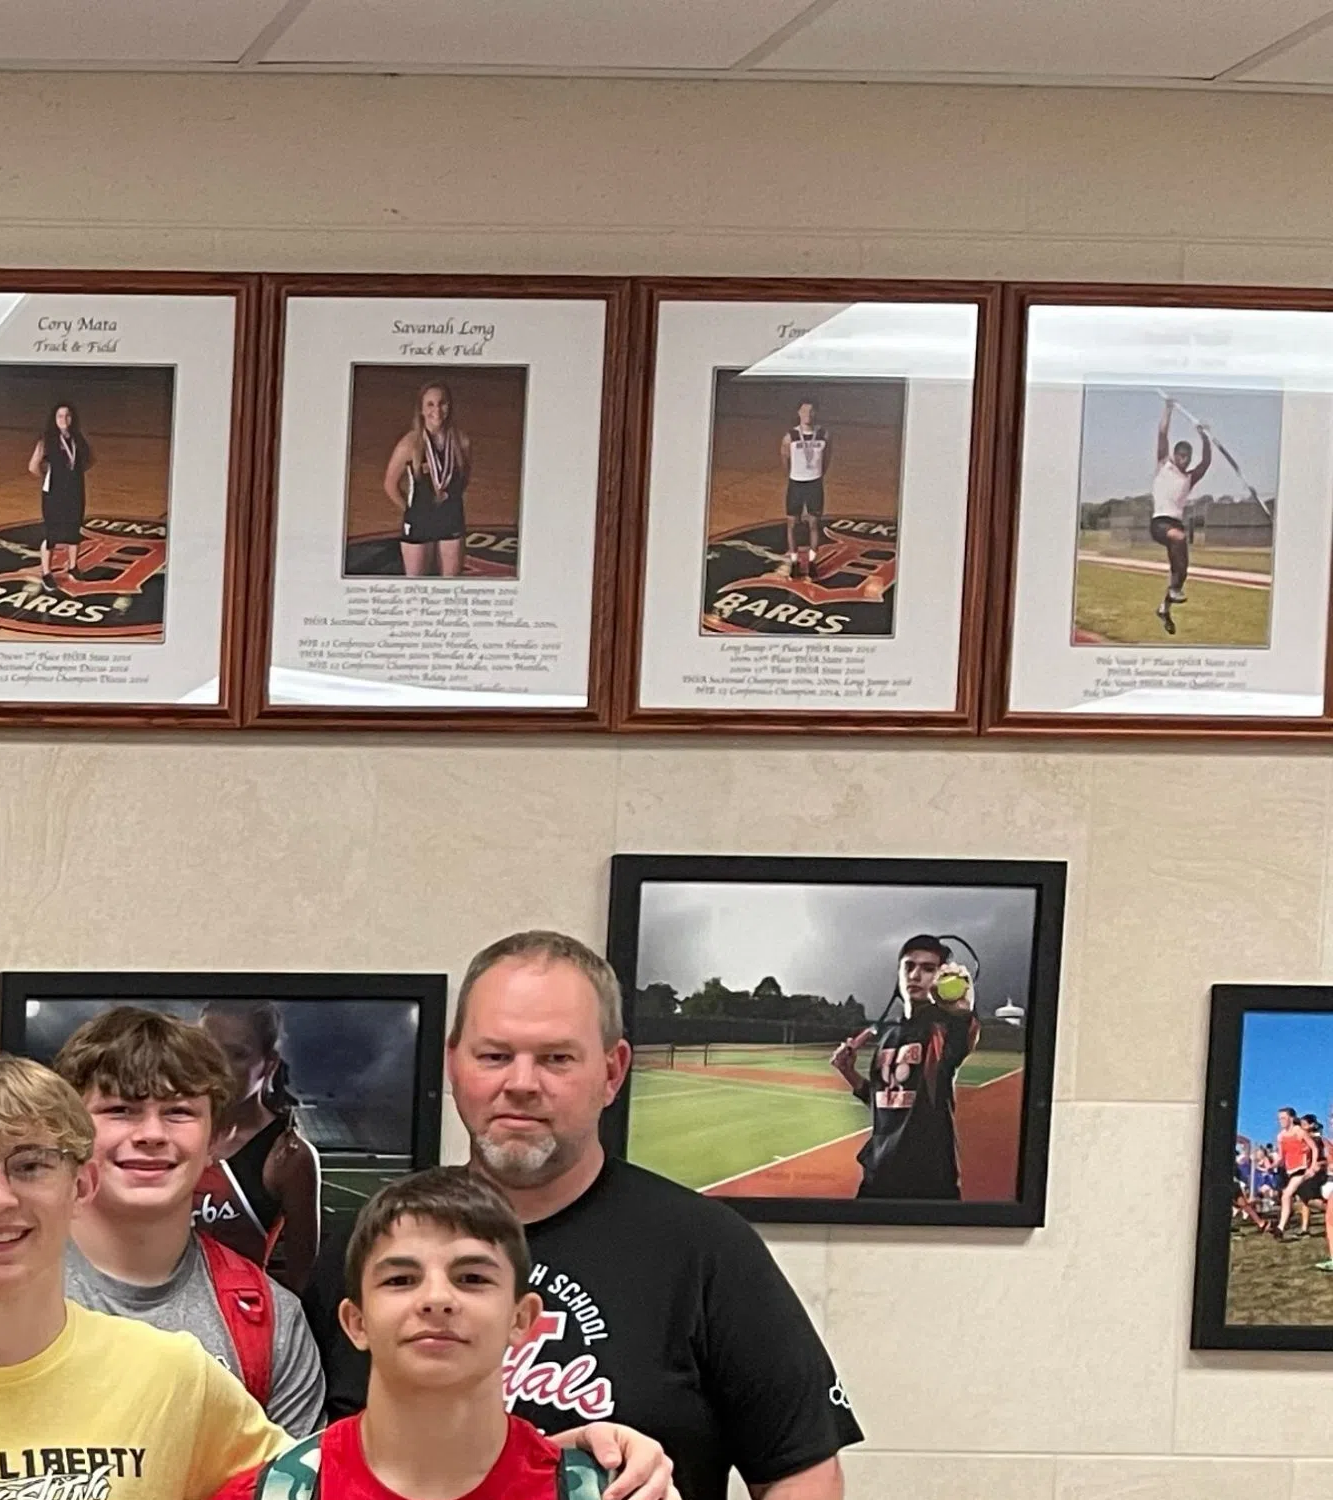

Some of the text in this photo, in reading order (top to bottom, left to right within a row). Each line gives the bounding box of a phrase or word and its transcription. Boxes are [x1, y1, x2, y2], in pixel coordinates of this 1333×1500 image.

[37, 316, 118, 338] Cory Mata
[392, 318, 495, 340] Savanah Long
[33, 338, 118, 354] Track & Field
[399, 342, 484, 357] Track & Field
[713, 589, 850, 635] BARBS
[191, 1194, 240, 1226] rbs
[547, 1274, 608, 1346] SCHOOL
[502, 1345, 615, 1420] dals
